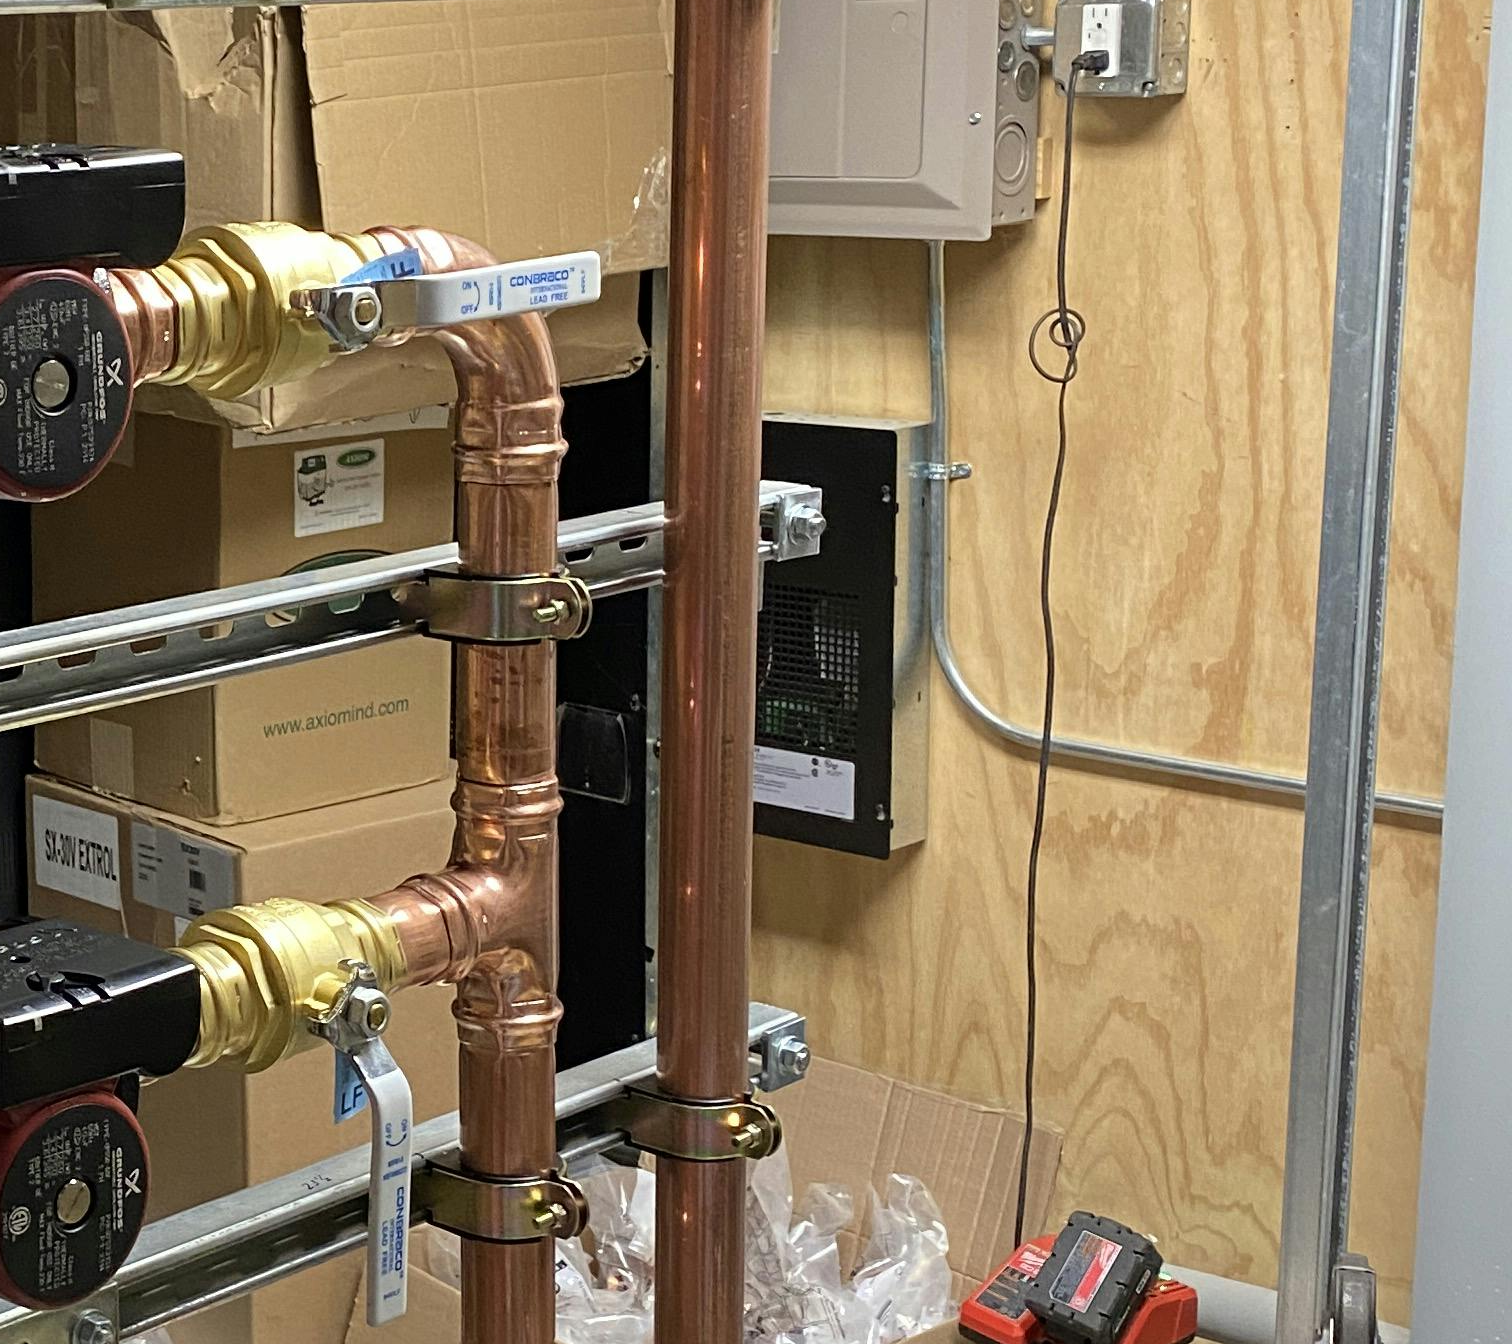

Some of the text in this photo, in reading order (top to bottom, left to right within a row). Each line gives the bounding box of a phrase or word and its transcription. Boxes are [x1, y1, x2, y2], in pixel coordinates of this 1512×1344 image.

[461, 281, 473, 291] ON
[529, 291, 569, 306] LEAD FREE
[460, 304, 474, 315] OFF
[96, 330, 107, 423] GRUNDFOS
[262, 697, 410, 739] www.axiomind.com
[44, 828, 76, 870] SX-30V
[78, 838, 118, 882] EXTROL
[341, 1084, 364, 1117] LF
[115, 1146, 125, 1233] GRUNDFOS
[381, 1220, 390, 1277] LEAD FREE
